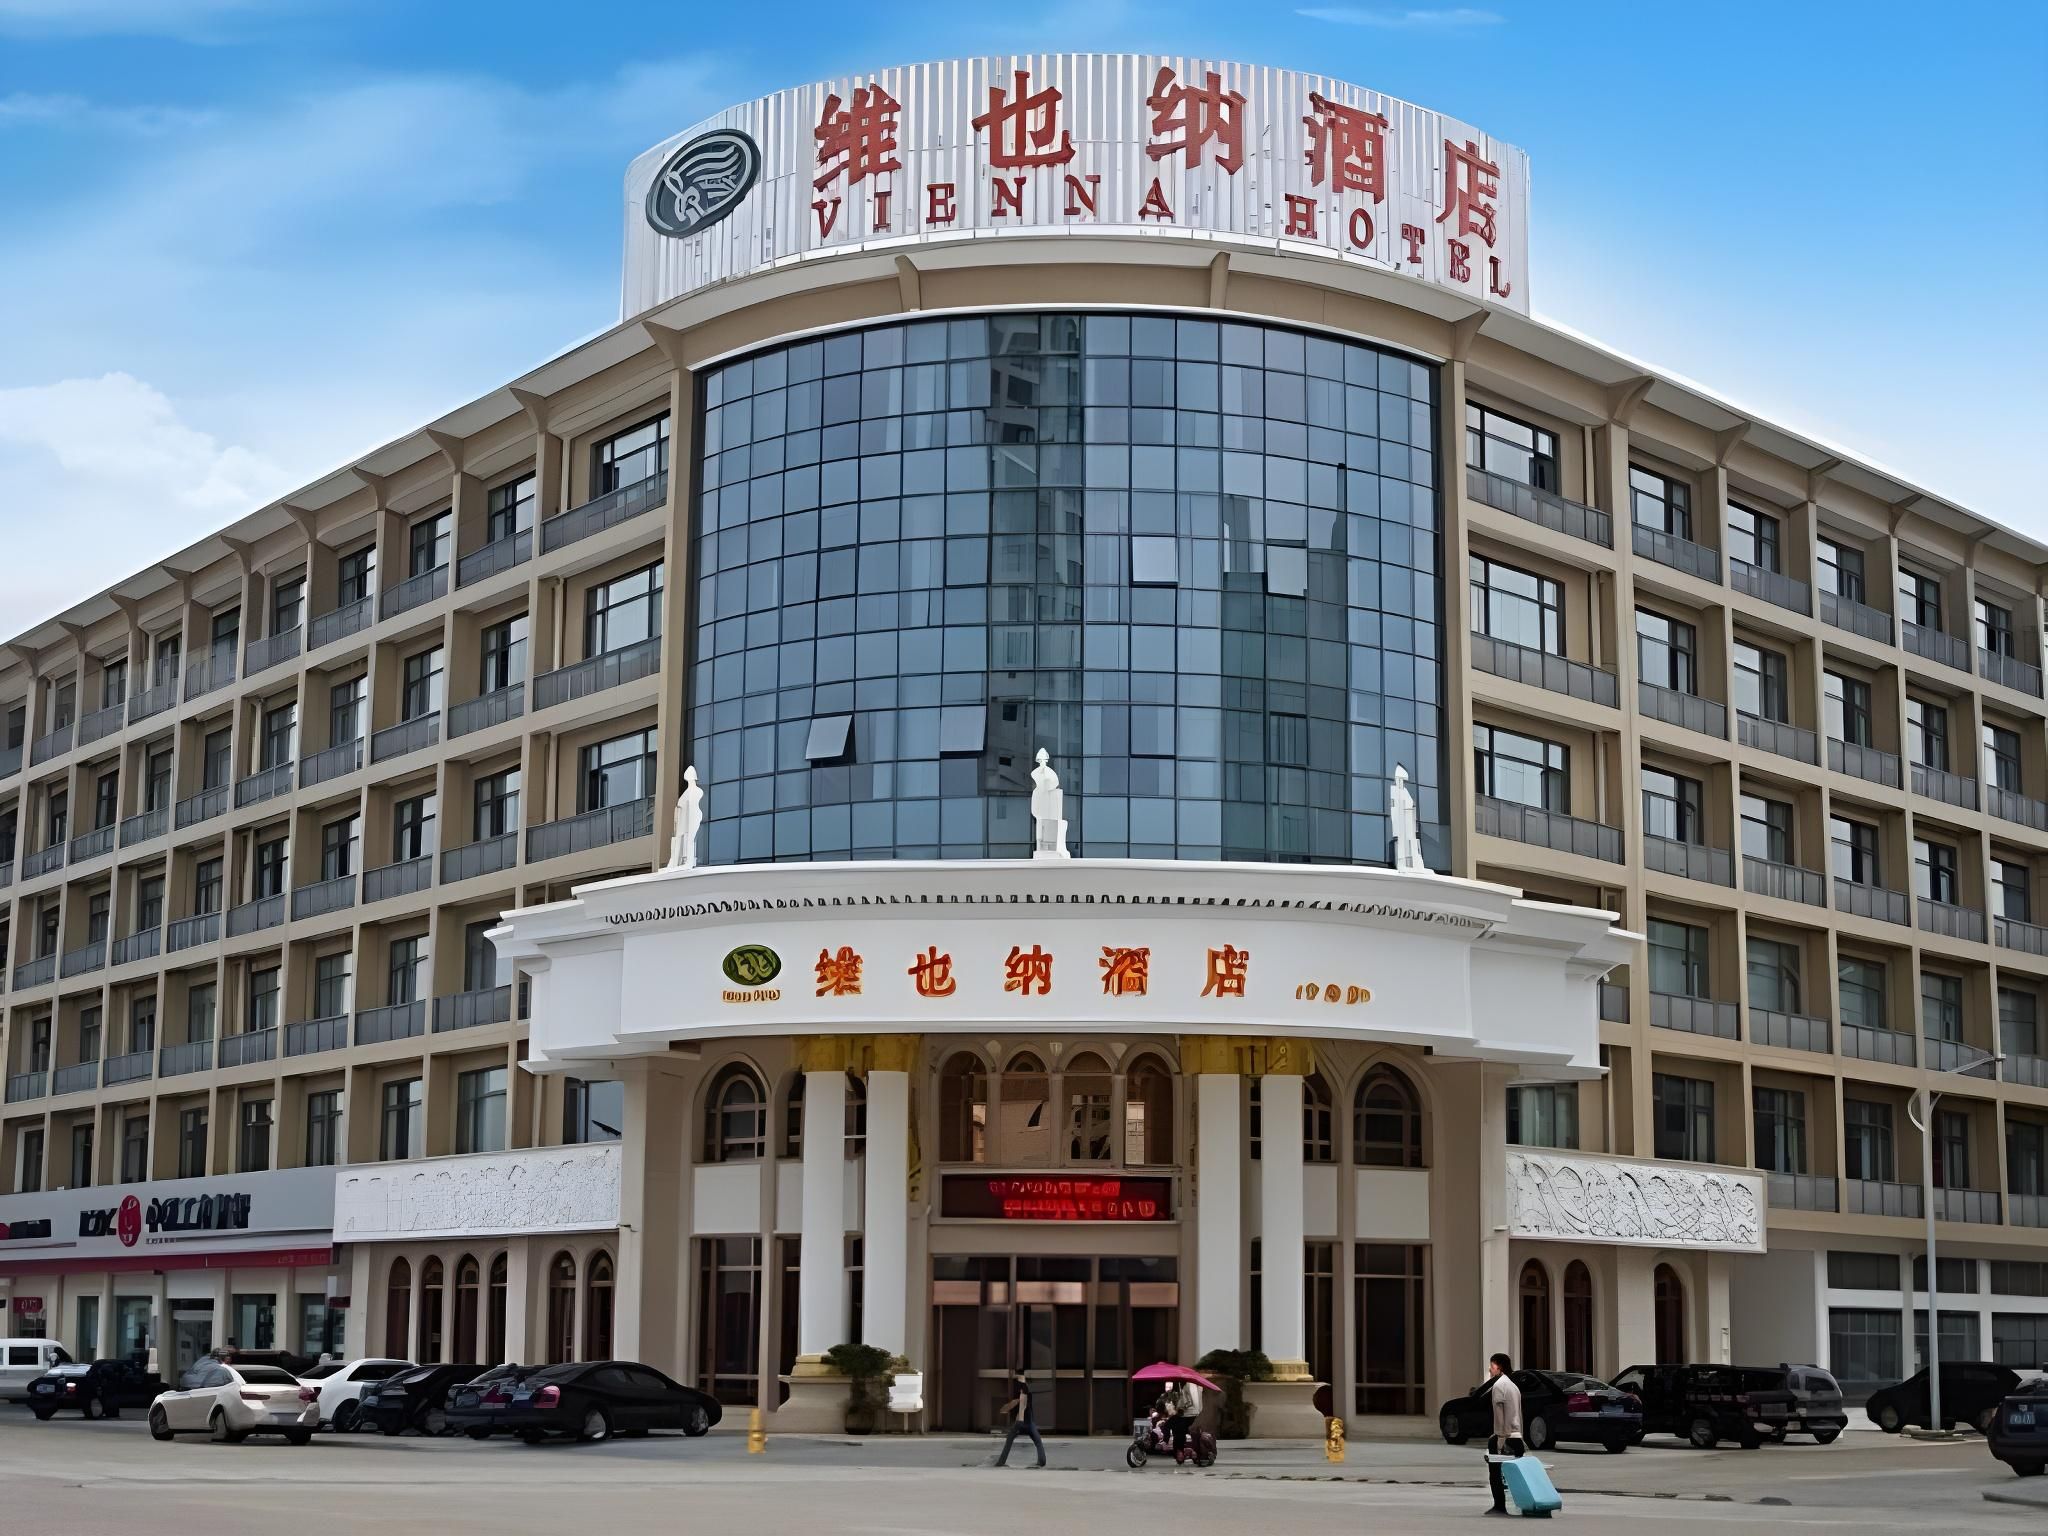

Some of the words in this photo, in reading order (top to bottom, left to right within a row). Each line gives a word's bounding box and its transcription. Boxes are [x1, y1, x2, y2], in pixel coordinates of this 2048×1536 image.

[811, 174, 1176, 239] VIENNA
[813, 66, 1500, 248] 维也纳酒店
